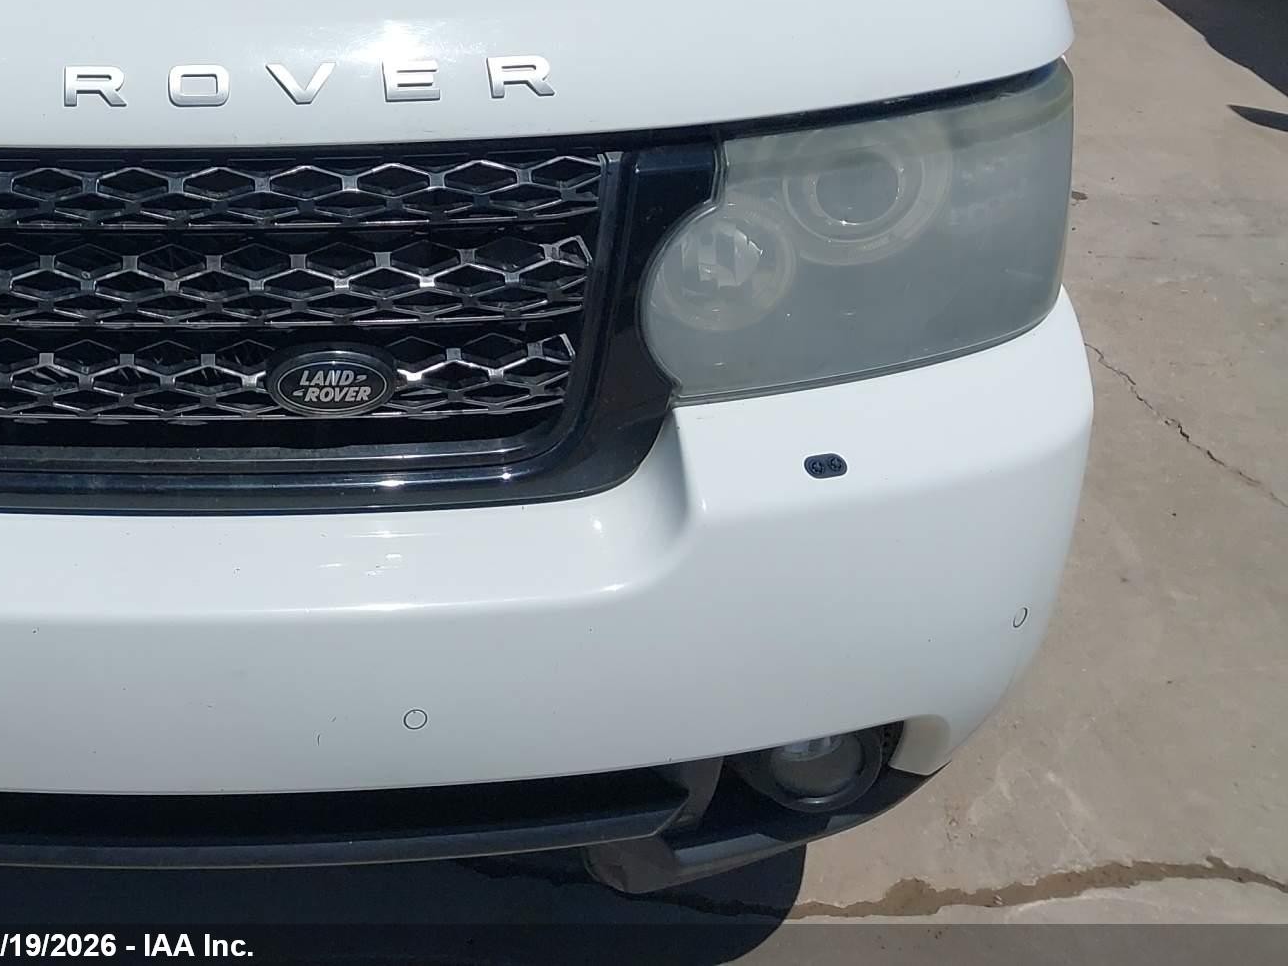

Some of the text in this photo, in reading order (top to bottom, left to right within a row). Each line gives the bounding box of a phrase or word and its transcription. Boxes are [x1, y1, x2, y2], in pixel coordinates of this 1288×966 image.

[63, 52, 558, 109] ROVER
[299, 370, 355, 386] LAND
[304, 386, 372, 403] ROVER
